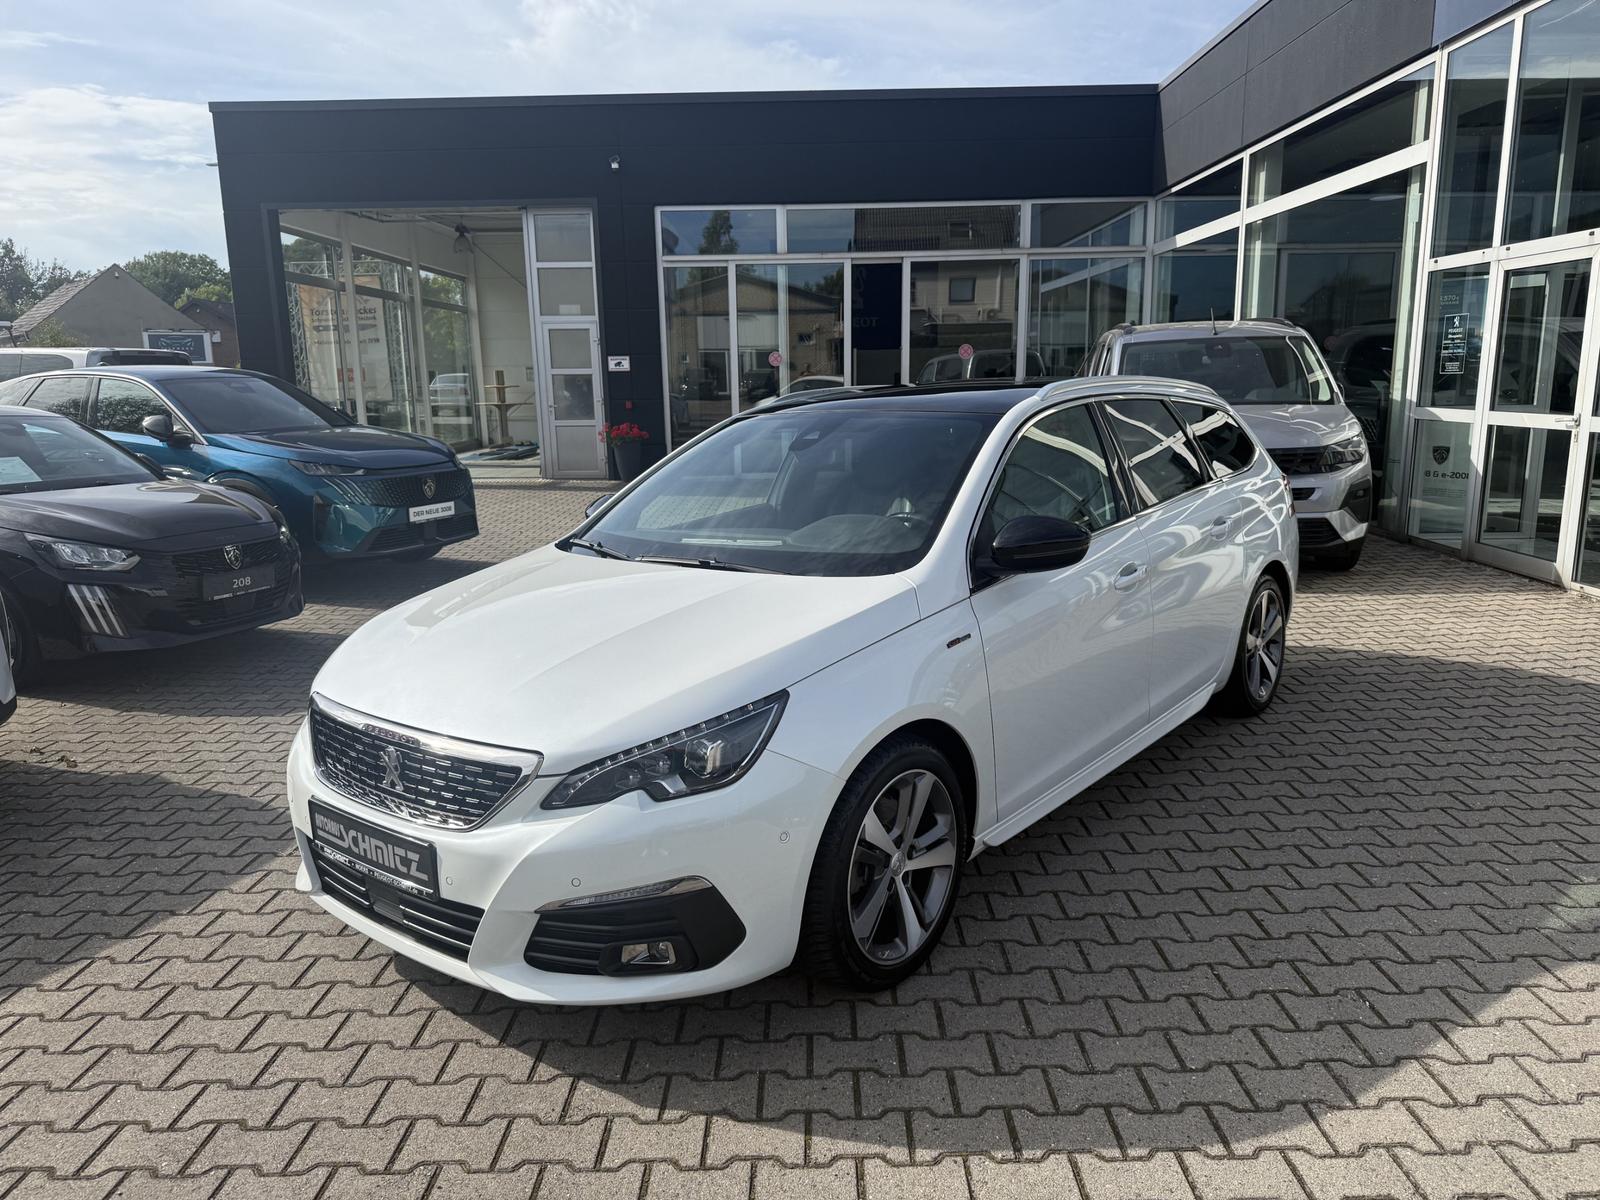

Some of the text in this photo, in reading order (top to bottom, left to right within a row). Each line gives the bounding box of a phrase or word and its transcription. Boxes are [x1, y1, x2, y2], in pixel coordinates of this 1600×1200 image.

[425, 507, 440, 515] NEUE
[232, 576, 251, 588] 208
[315, 811, 429, 881] AUTOHAUS SCHMITZ
